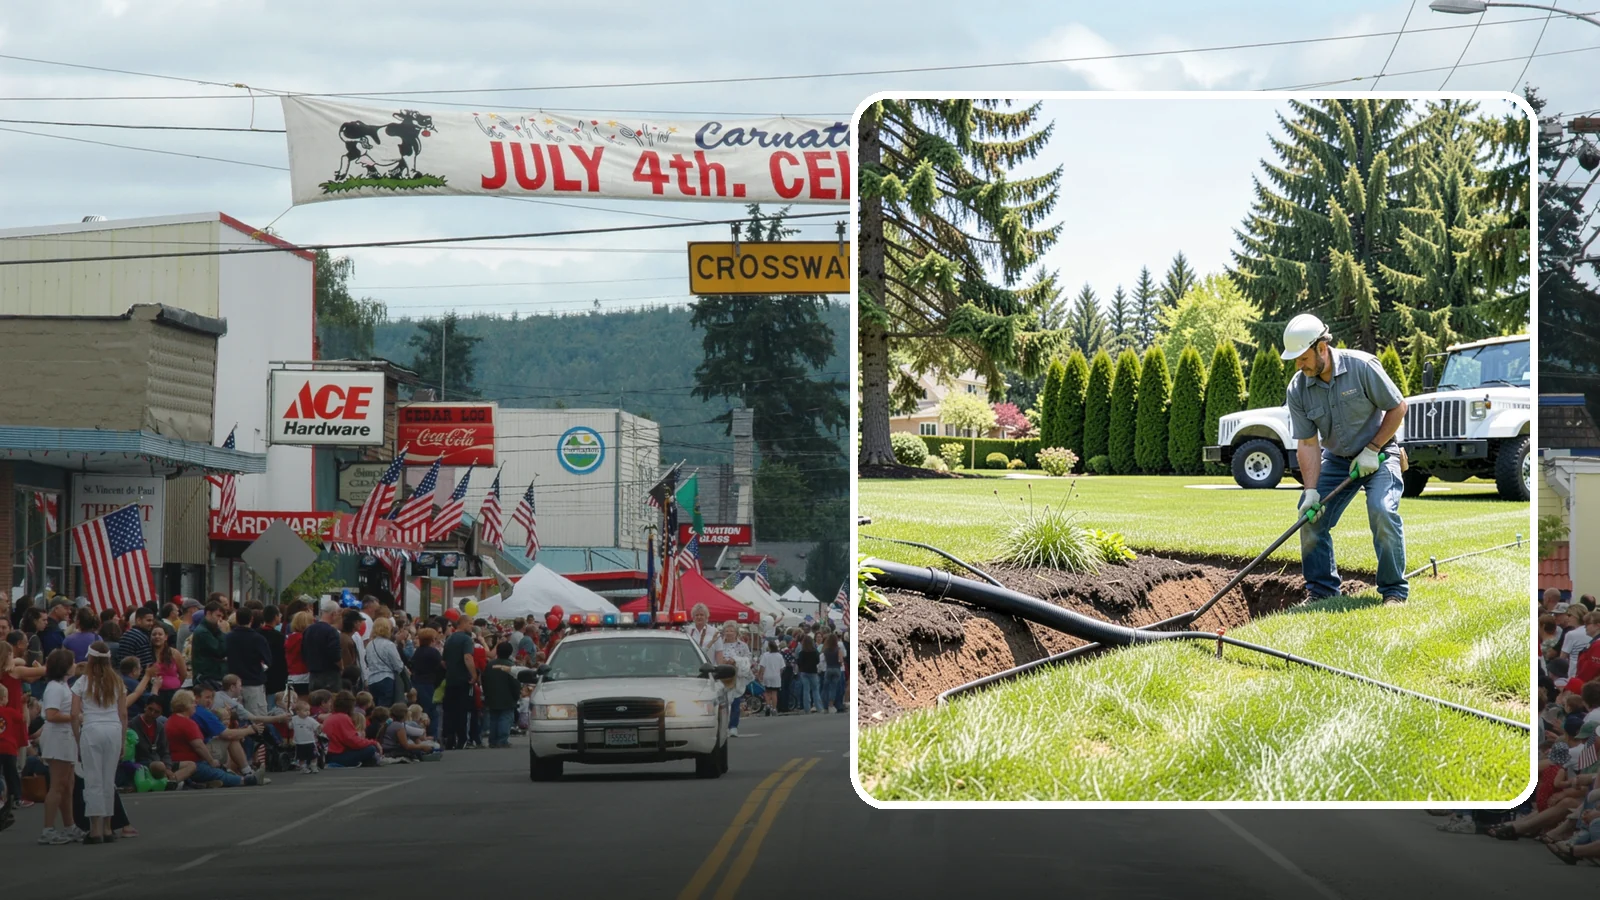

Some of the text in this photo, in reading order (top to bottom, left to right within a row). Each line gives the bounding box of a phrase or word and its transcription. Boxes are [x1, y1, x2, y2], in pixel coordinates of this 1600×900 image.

[695, 121, 850, 150] Carnat
[481, 141, 605, 192] JULY
[632, 151, 746, 198] 4th.
[697, 254, 850, 280] CROSSWA
[283, 380, 374, 420] ACE
[284, 421, 371, 436] Hardware
[416, 428, 477, 447] Coca-Cola
[353, 467, 385, 480] Simpl
[95, 485, 124, 495] Vincent
[126, 486, 136, 495] de
[138, 486, 155, 495] Paul
[213, 516, 331, 535] HARDARE
[688, 526, 741, 535] CRNATION
[699, 535, 730, 543] GLASS
